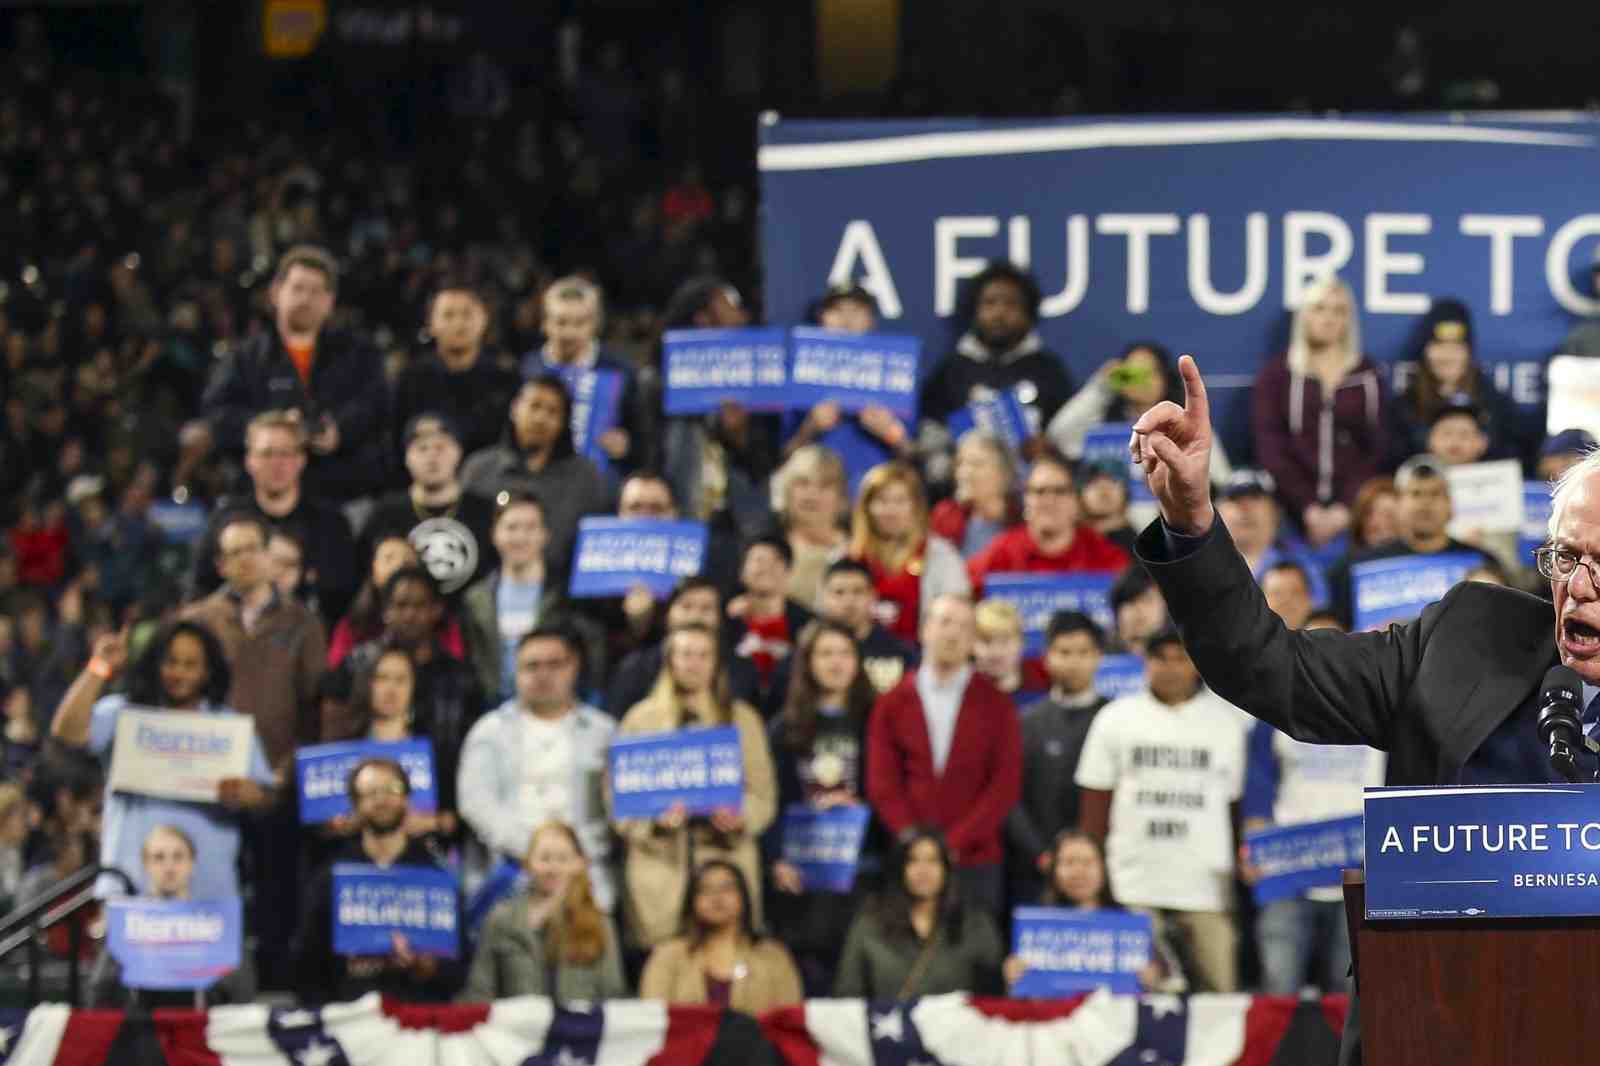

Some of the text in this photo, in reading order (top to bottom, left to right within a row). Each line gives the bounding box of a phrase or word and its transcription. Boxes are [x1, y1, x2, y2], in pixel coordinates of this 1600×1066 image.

[824, 219, 903, 319] A
[934, 212, 1433, 317] FUTURE
[1381, 826, 1404, 853] A
[1413, 824, 1549, 853] FUTURE
